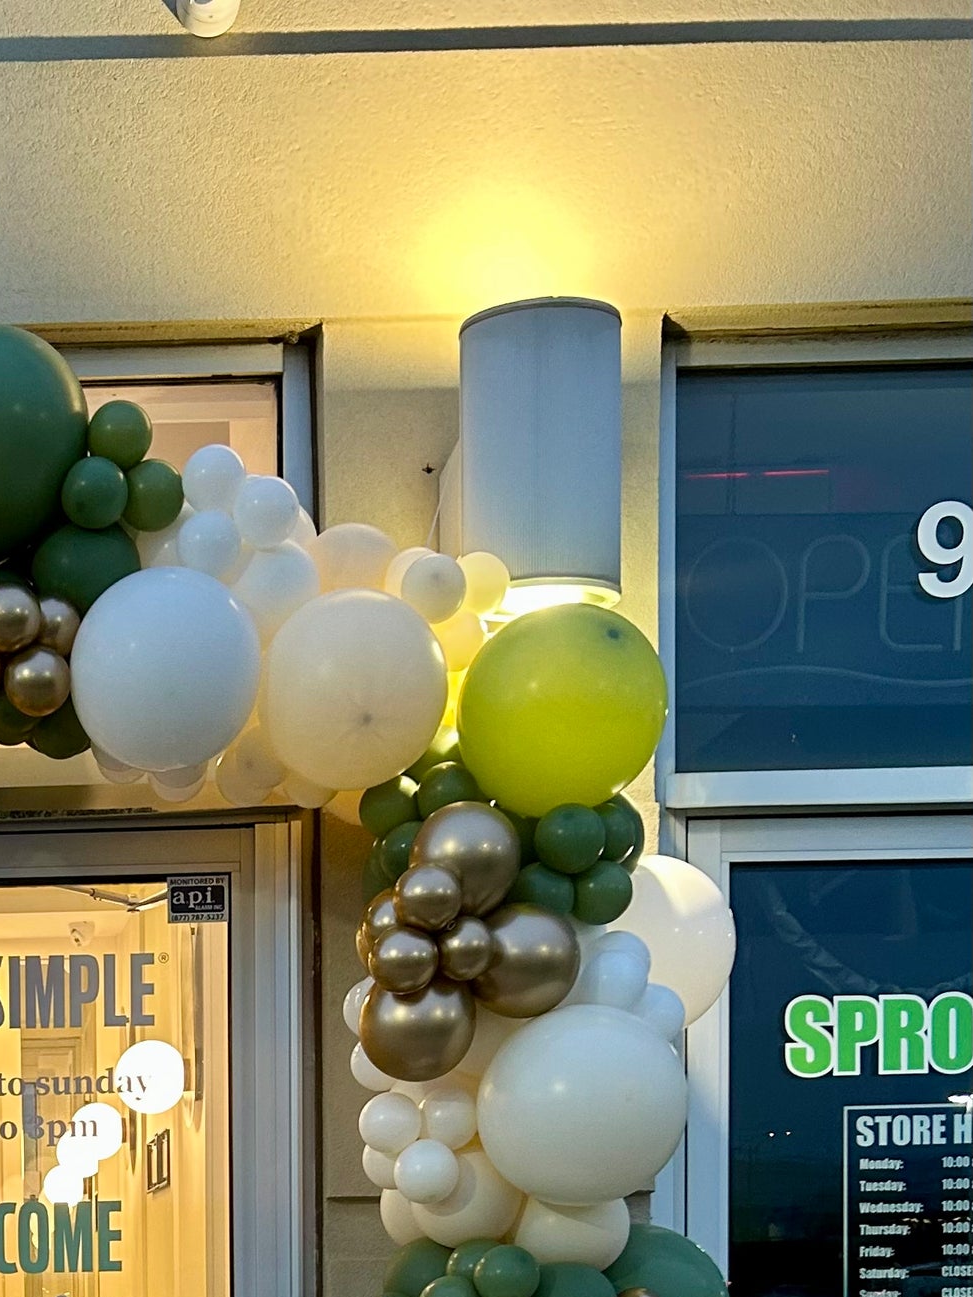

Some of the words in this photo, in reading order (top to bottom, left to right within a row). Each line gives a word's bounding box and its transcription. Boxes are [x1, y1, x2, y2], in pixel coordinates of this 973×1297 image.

[917, 500, 973, 599] 9
[685, 533, 963, 653] OPE
[784, 991, 973, 1079] SPRO
[36, 1067, 155, 1101] sunday
[856, 1114, 947, 1147] STORE
[859, 1158, 904, 1170] Monday:
[941, 1155, 970, 1168] 10:00
[859, 1179, 907, 1192] Tuesday:
[941, 1177, 970, 1190] 10:00
[859, 1201, 924, 1214] Wednesday:
[941, 1199, 970, 1212] 10:00
[859, 1223, 911, 1236] Thursday:
[941, 1221, 970, 1234] 10:00
[859, 1245, 895, 1258] Friday:
[941, 1243, 970, 1256] 10:00
[859, 1267, 910, 1280] Saturday:
